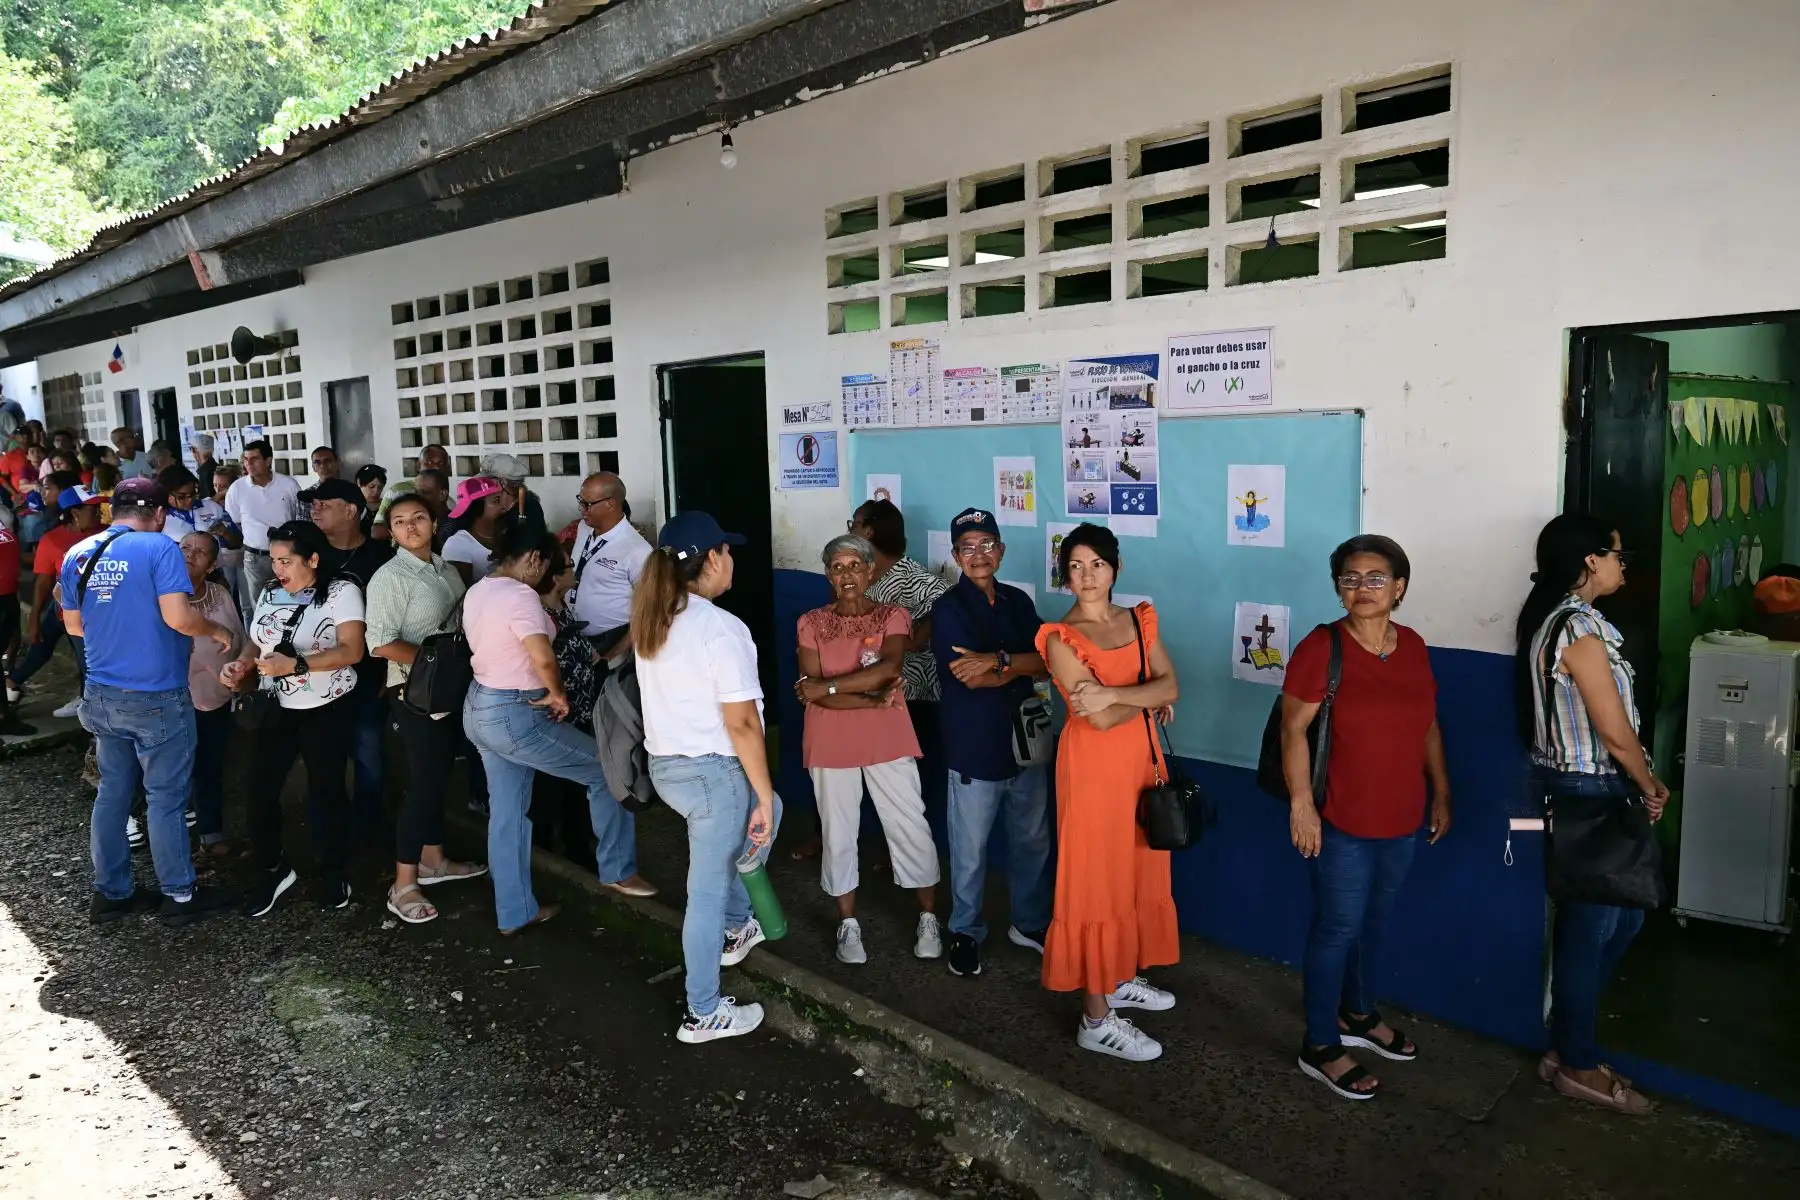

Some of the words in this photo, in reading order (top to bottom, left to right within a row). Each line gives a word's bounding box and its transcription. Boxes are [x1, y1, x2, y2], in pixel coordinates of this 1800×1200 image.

[1170, 347, 1190, 357] Para
[1192, 345, 1214, 355] votar
[1216, 343, 1243, 353] debes
[1245, 341, 1267, 351] usar
[1177, 364, 1185, 373] el
[1188, 362, 1220, 374] gancho
[1230, 361, 1239, 370] la
[1241, 360, 1260, 369] cruz
[784, 408, 801, 424] Mesa
[89, 572, 124, 581] ASTILLO
